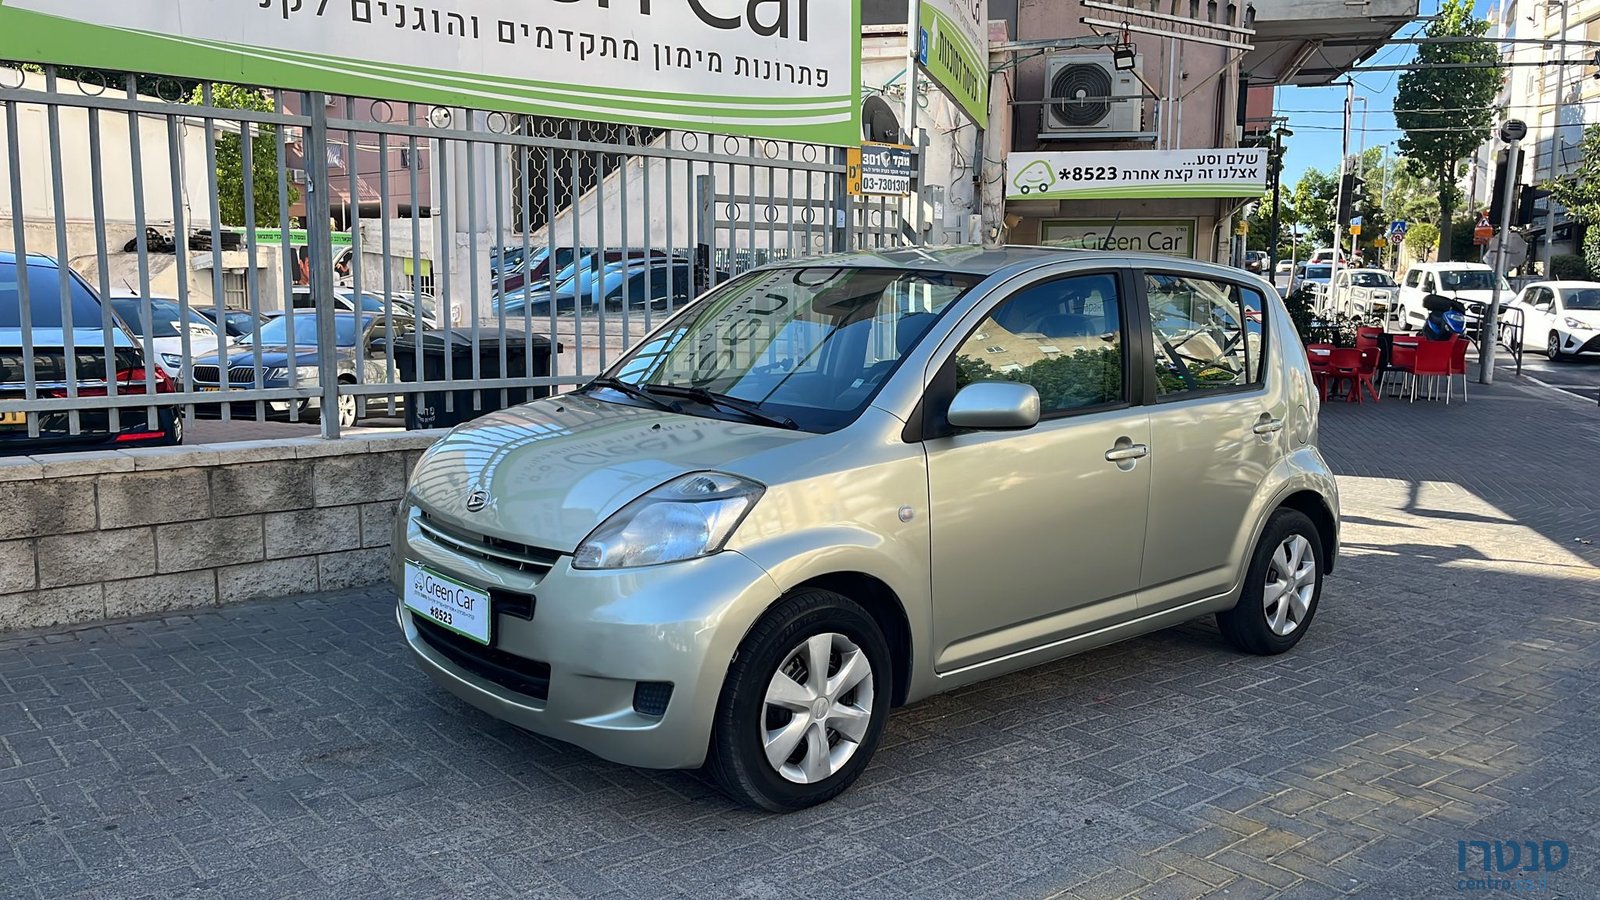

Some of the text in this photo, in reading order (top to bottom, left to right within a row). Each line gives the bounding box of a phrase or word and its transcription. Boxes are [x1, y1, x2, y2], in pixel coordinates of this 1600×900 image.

[351, 0, 479, 39] והוגנים
[498, 20, 639, 62] מתקדמים
[653, 43, 722, 73] מימון
[734, 56, 829, 88] פתרונות
[862, 153, 881, 166] 301
[1183, 152, 1258, 166] שלם וסע...
[1122, 169, 1160, 180] אחרת
[1164, 169, 1193, 182] קצת
[1198, 168, 1214, 179] זה
[1218, 166, 1258, 179] אצלנו
[863, 177, 909, 192] 03-7301301
[1082, 231, 1183, 251] Green Car
[425, 575, 454, 604] Green
[455, 588, 475, 612] Car
